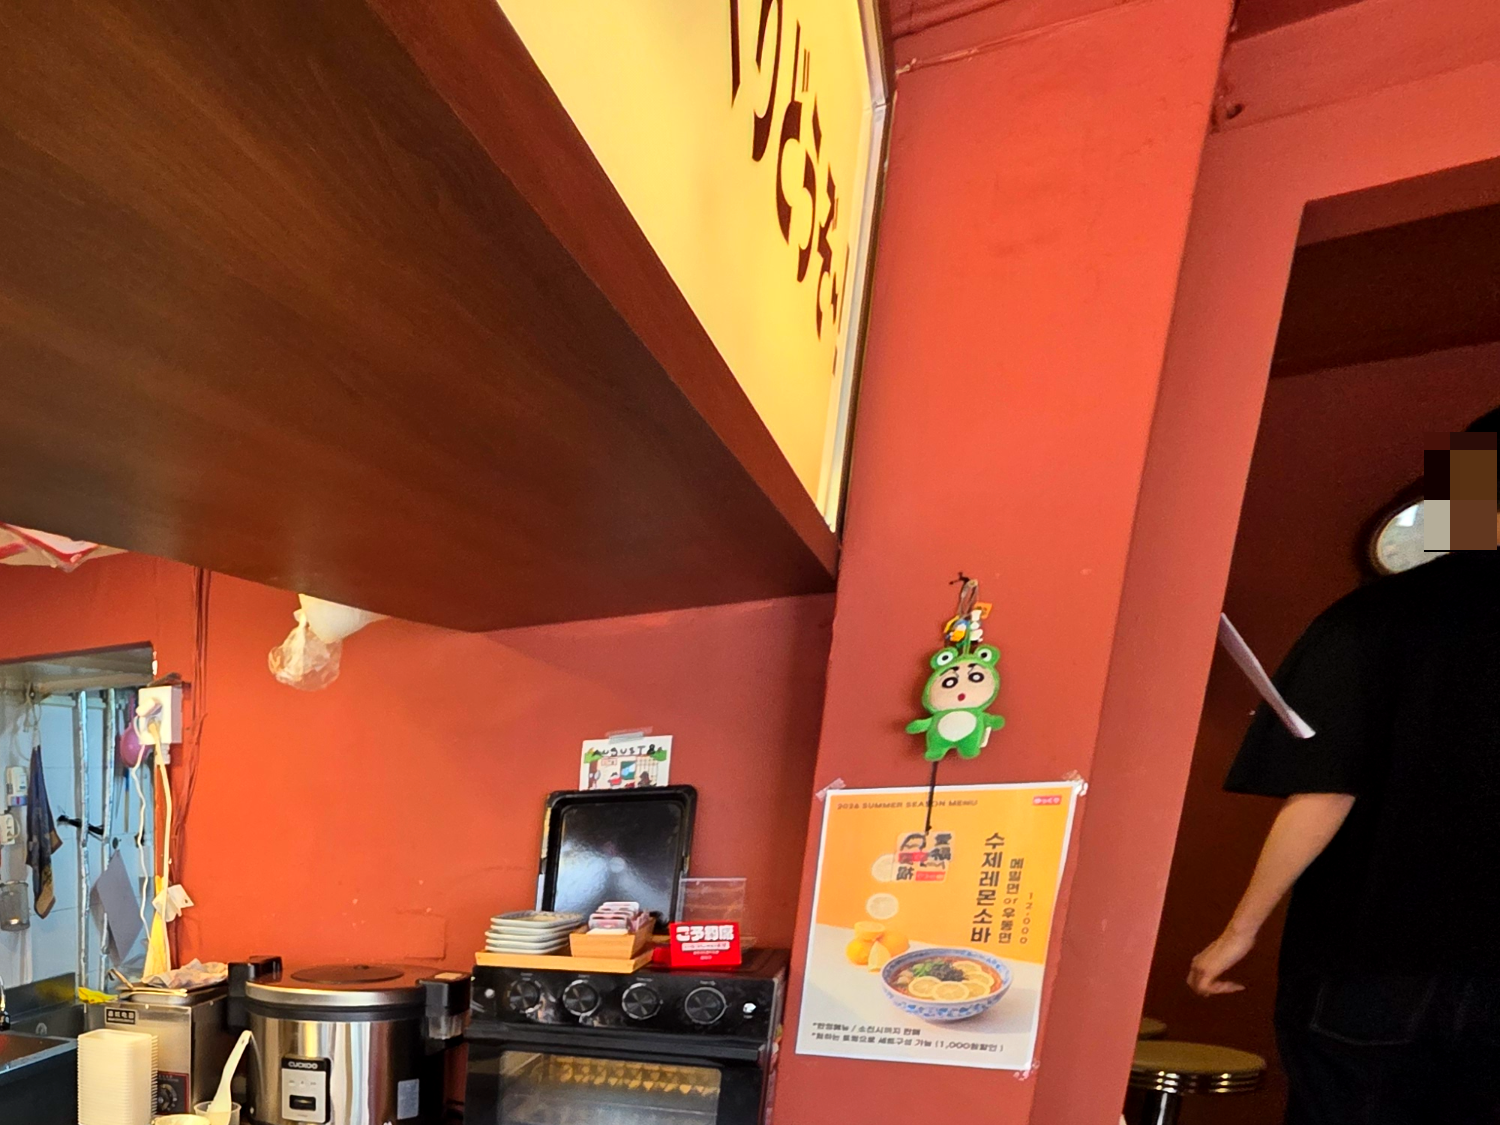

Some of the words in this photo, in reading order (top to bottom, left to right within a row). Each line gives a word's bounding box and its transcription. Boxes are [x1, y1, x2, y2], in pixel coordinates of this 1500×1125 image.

[948, 799, 978, 807] MENU
[970, 832, 1005, 943] 수제레몬소바
[1003, 897, 1018, 905] or
[998, 907, 1016, 944] 우동면
